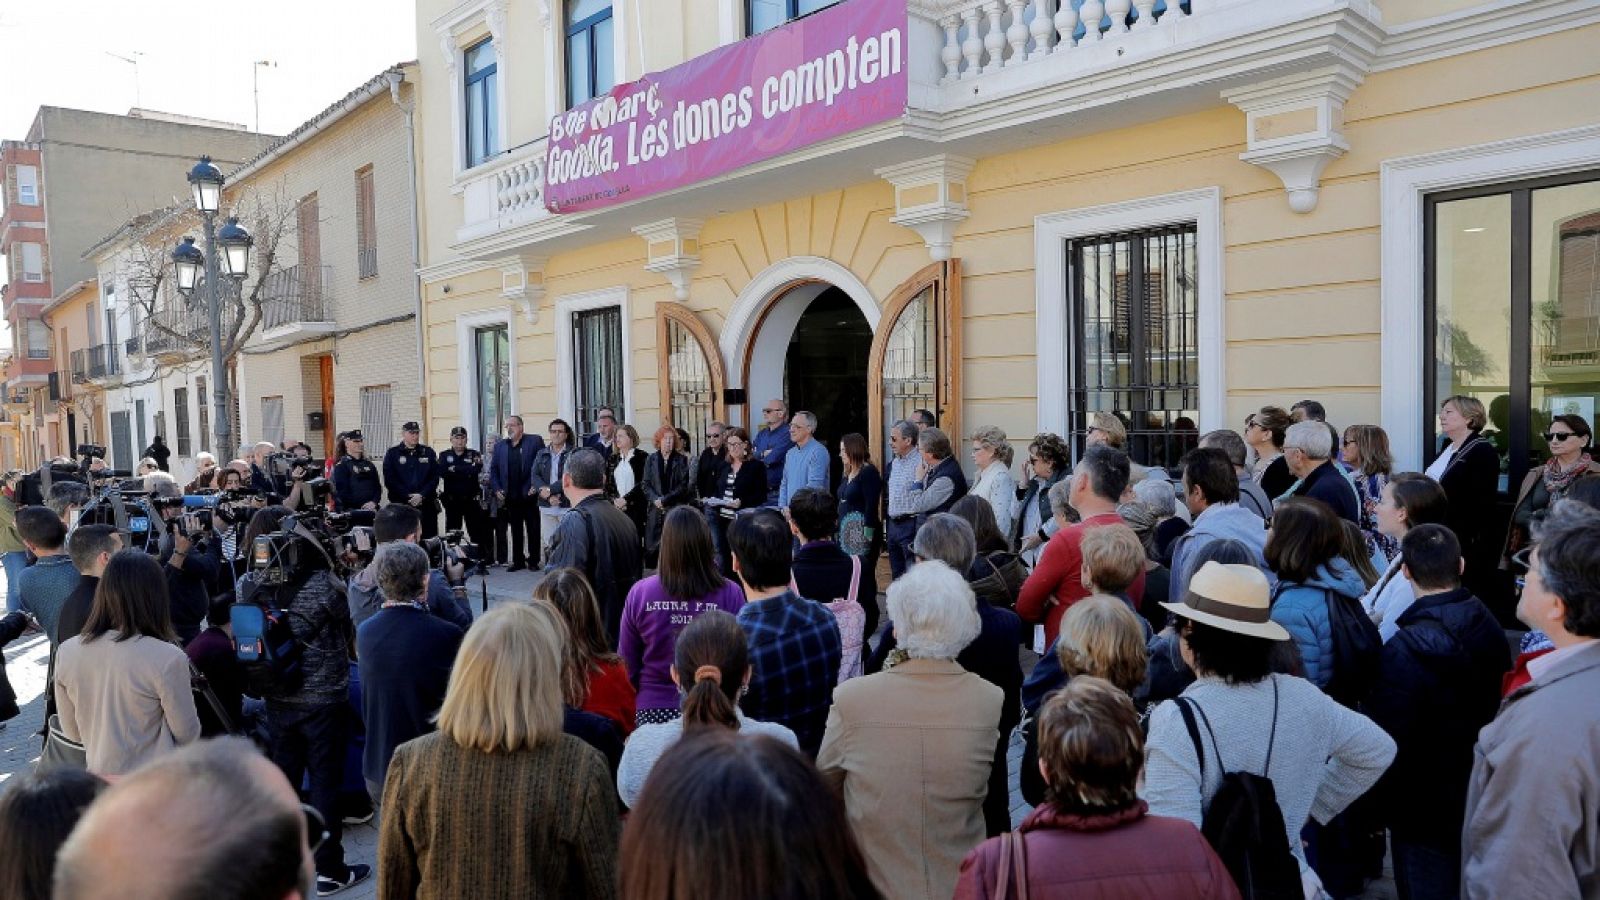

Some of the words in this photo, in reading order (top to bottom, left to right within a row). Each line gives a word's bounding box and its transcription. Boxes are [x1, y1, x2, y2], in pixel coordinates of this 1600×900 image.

[627, 118, 669, 165] Les
[673, 86, 752, 150] dones
[762, 27, 900, 119] compten
[130, 518, 148, 529] tve
[645, 601, 689, 612] LAURA
